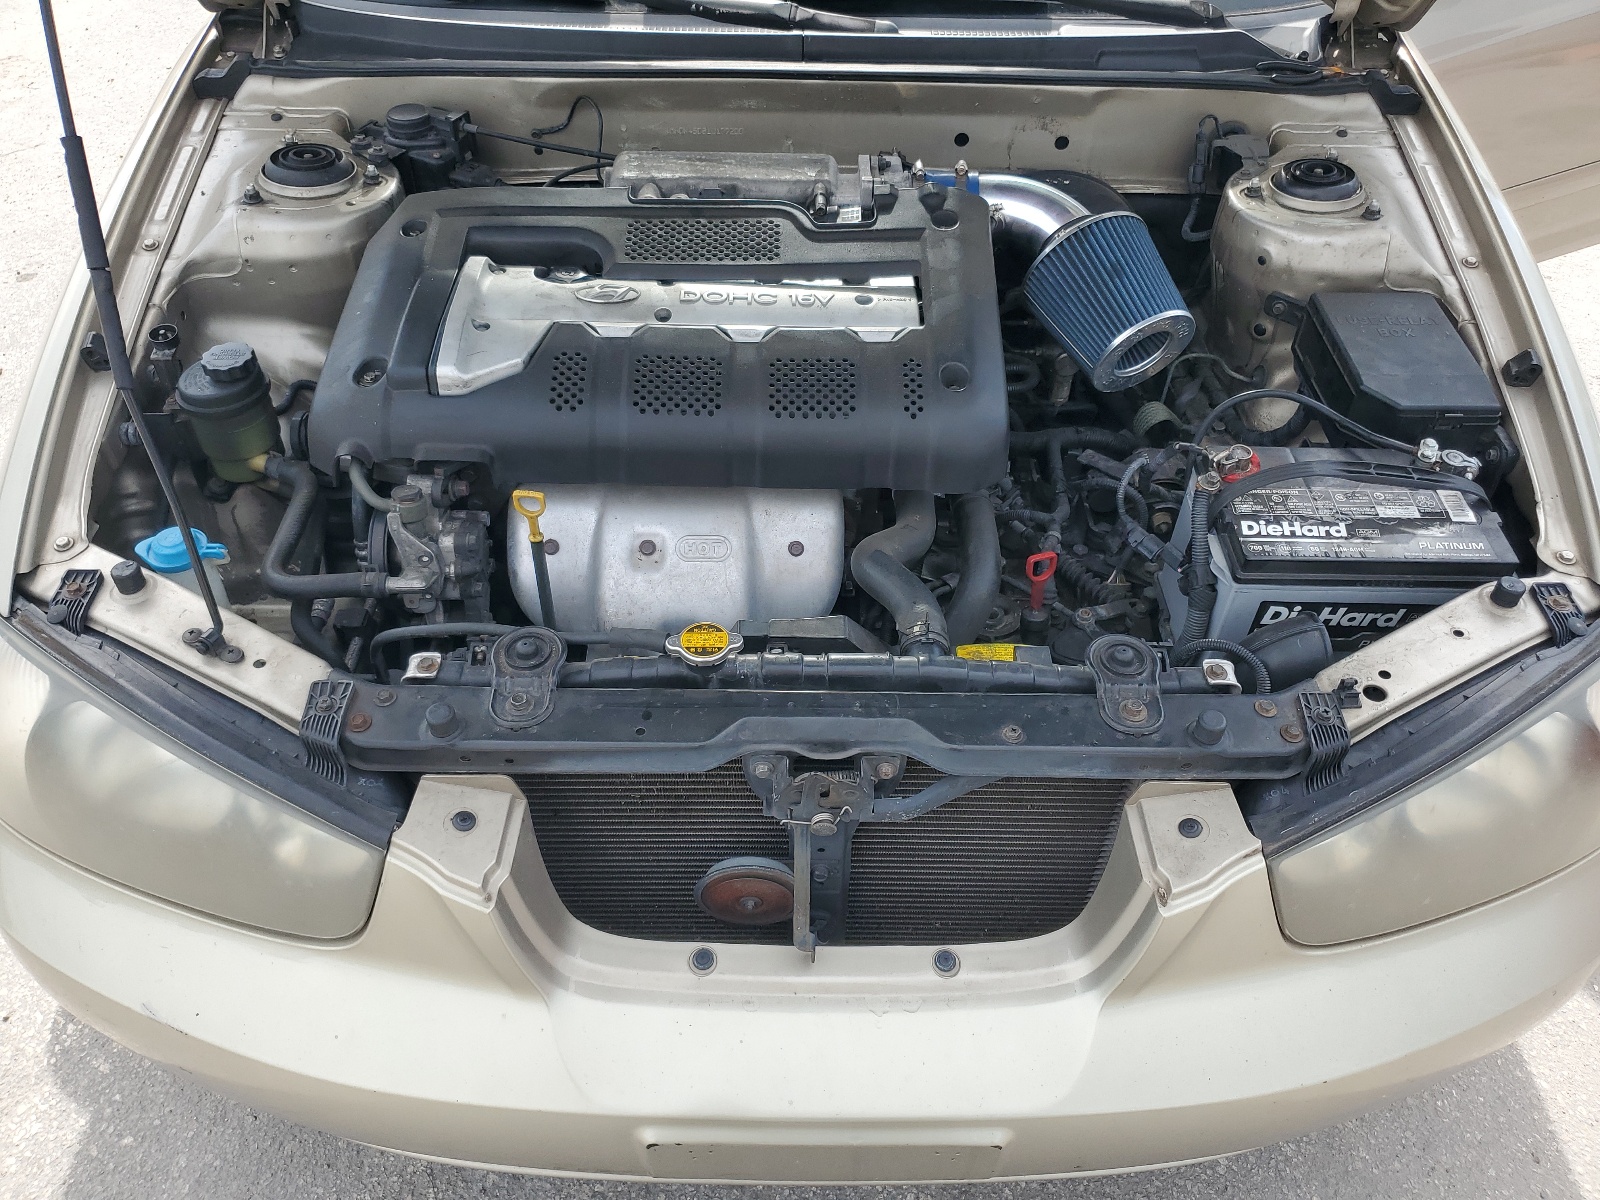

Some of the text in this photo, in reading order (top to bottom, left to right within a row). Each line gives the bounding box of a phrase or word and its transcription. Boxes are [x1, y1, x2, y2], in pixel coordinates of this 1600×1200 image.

[678, 289, 836, 308] DOHC 16V
[1335, 315, 1439, 326] FUSE-RELAY
[1377, 328, 1416, 338] BOX
[1240, 520, 1348, 538] DieHard
[682, 541, 722, 557] HOT
[1418, 541, 1485, 550] PLATINUM
[1260, 606, 1408, 628] DiHard
